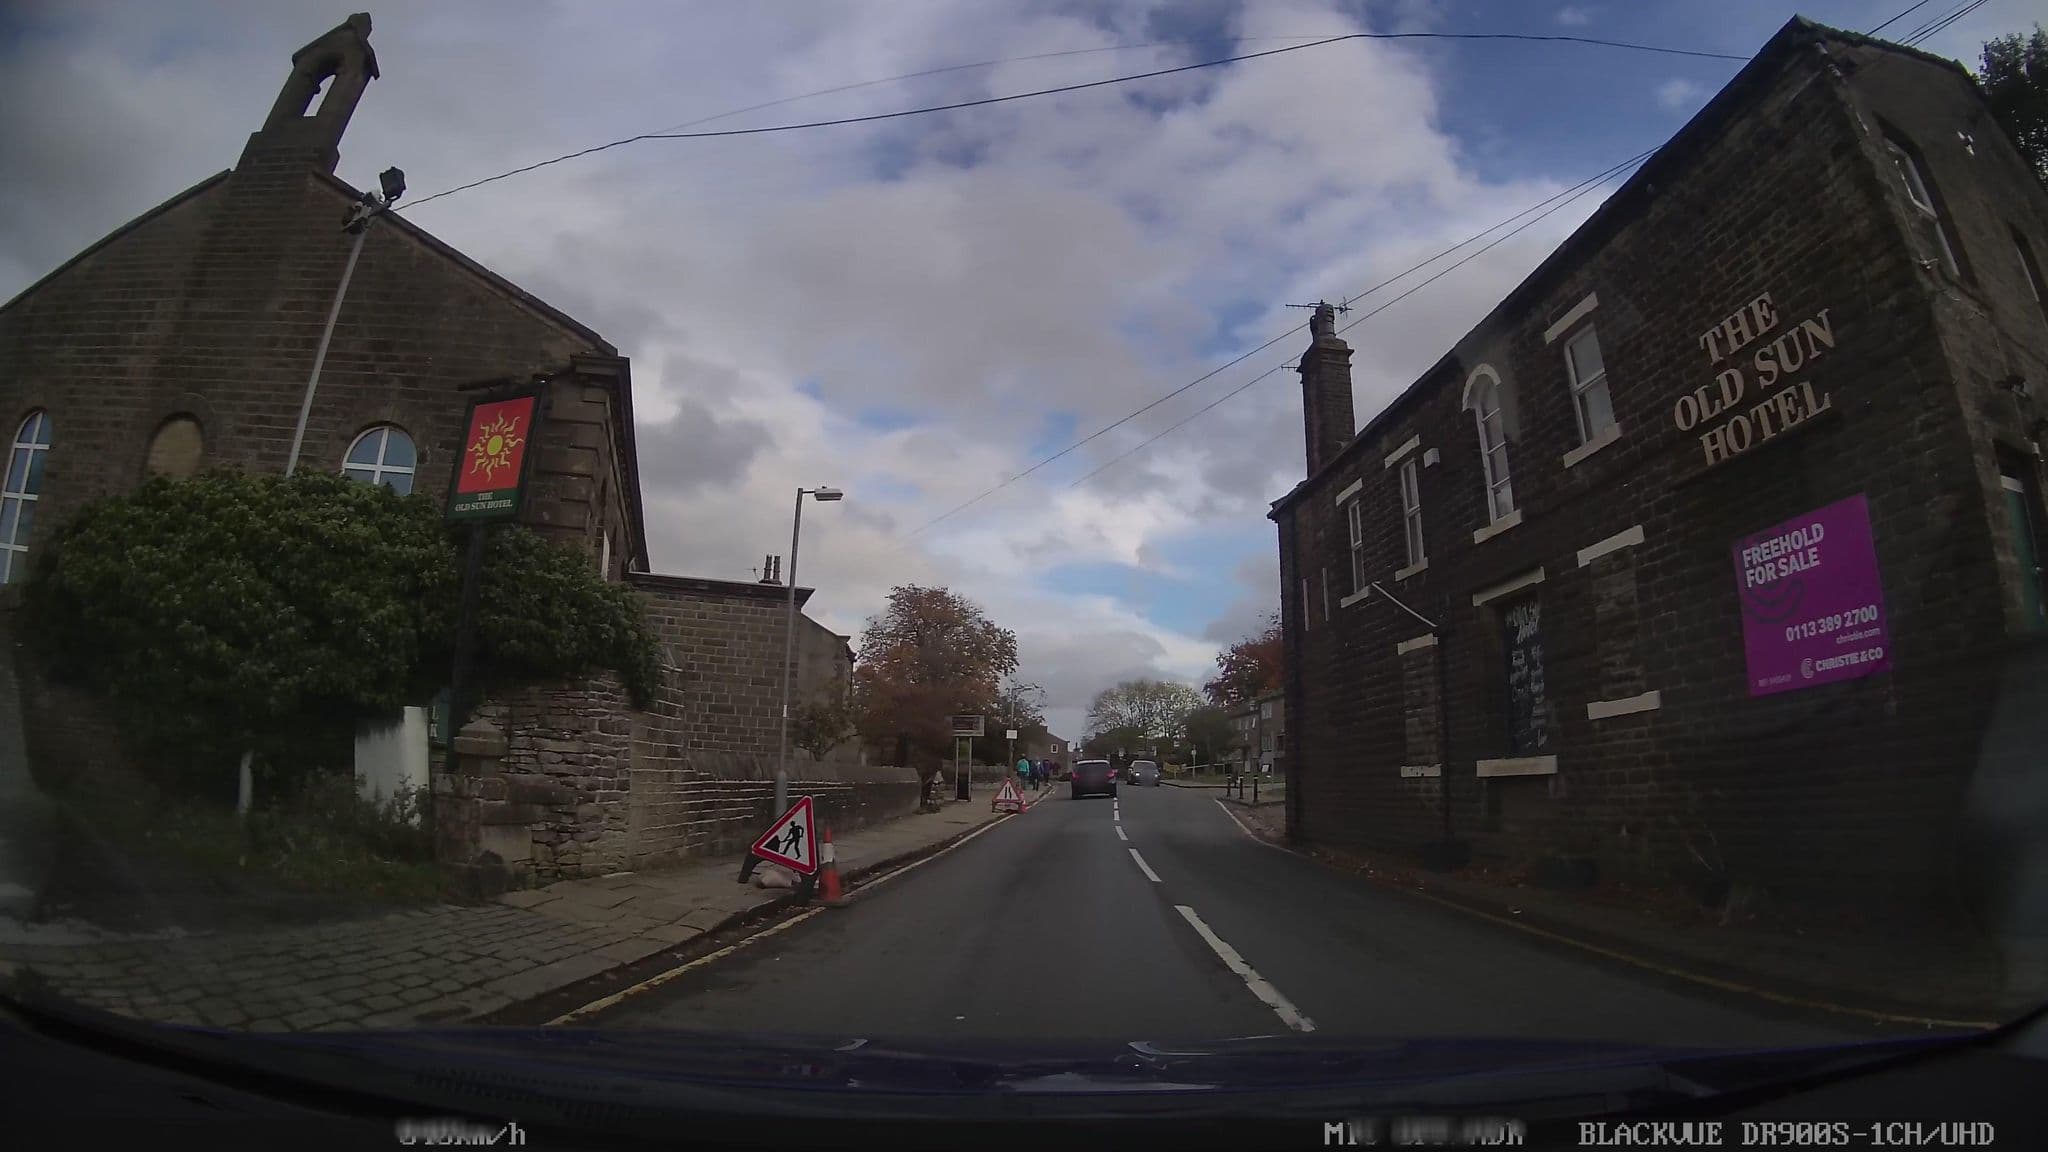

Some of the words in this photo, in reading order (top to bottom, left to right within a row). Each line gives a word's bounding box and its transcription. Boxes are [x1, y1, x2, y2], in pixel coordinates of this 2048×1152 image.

[1699, 292, 1779, 366] THE
[1674, 368, 1745, 431] OLD
[1754, 308, 1835, 389] SUN
[1699, 381, 1832, 466] HOTEL
[455, 503, 470, 511] OLD
[471, 501, 486, 510] SUN
[486, 499, 513, 509] HOTEL
[478, 492, 493, 500] THE
[1742, 523, 1824, 568] FREEHOLD
[1745, 562, 1777, 588] FOR
[1779, 547, 1820, 577] SALE
[1786, 621, 1816, 642] 0113
[1818, 614, 1841, 633] 389
[1843, 605, 1878, 628] 2700
